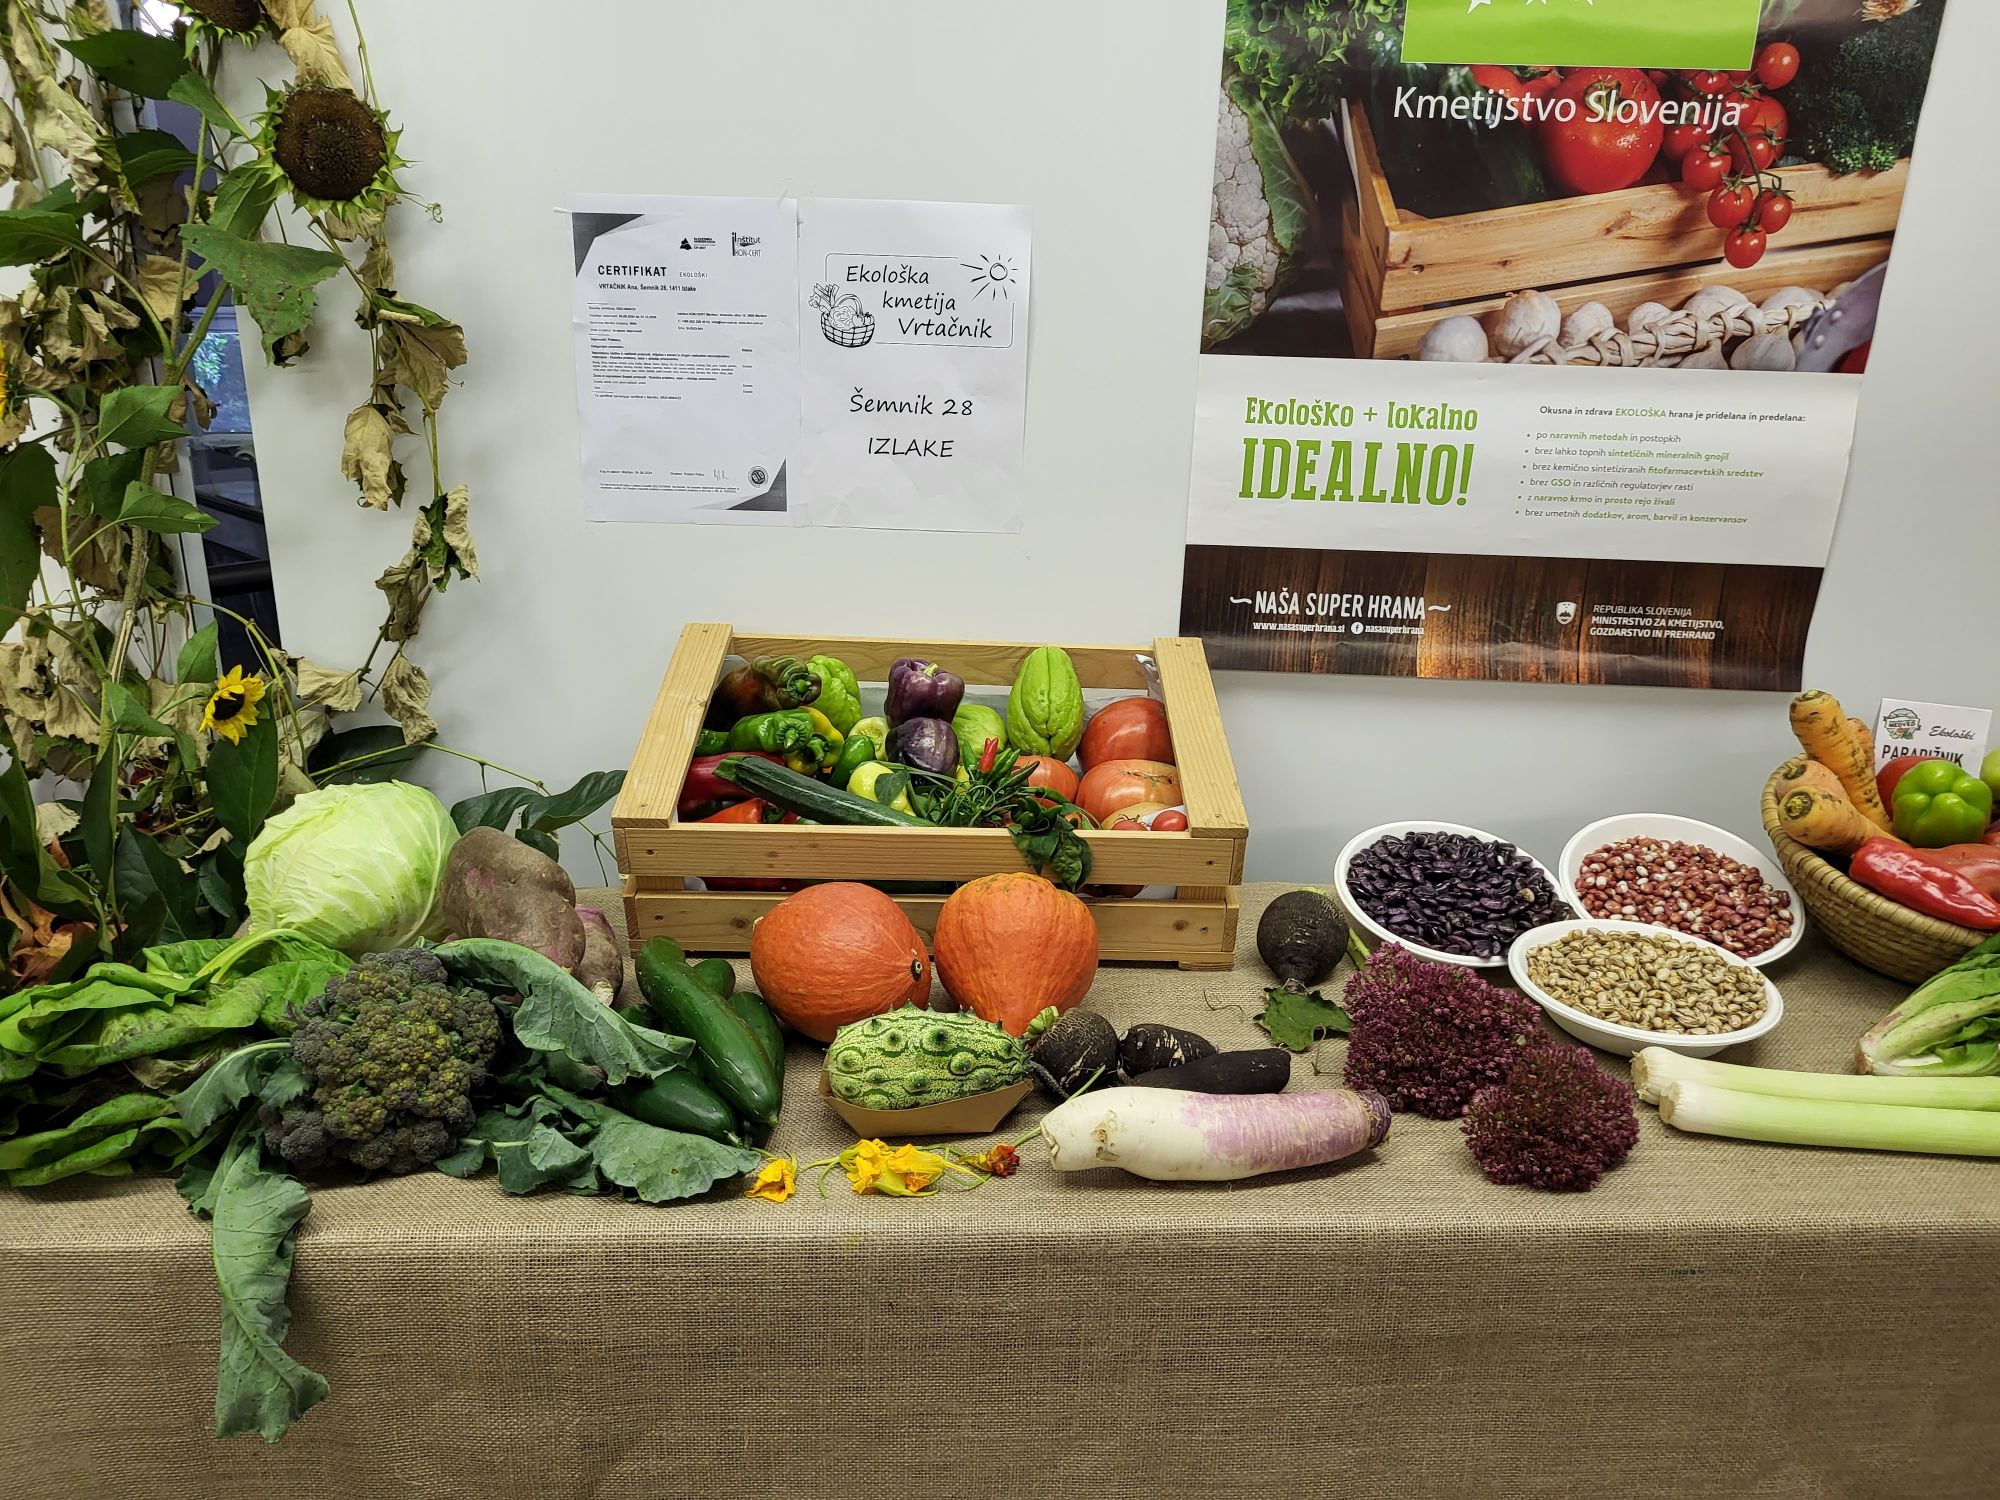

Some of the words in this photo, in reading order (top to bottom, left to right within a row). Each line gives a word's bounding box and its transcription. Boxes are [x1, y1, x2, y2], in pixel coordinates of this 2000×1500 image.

[1393, 86, 1577, 130] Kmetijstvo
[1585, 89, 1744, 135] Slovenija
[597, 265, 667, 277] CERTIFIKAT
[846, 264, 929, 284] Ekološka
[640, 283, 660, 291] Šemnik
[882, 290, 956, 316] kmetija
[898, 316, 992, 338] Vrtačnik
[850, 386, 933, 415] Šemnik
[942, 399, 973, 416] 28
[1245, 396, 1354, 428] Ekološko
[1363, 406, 1378, 422] +
[1387, 401, 1478, 431] lokalno
[1539, 406, 1572, 415] Okusna
[1574, 407, 1583, 415] in
[1585, 407, 1613, 416] zdrava
[1615, 407, 1666, 417] EKOLOŠKA
[1668, 410, 1693, 418] hrana
[1695, 411, 1703, 420] je
[1705, 411, 1747, 421] pridelana
[1749, 412, 1757, 420] in
[1759, 413, 1806, 423] predelana:
[1536, 432, 1548, 440] po
[1550, 432, 1587, 440] naravnih
[1589, 433, 1628, 441] metodah
[1639, 435, 1681, 444] postopkih
[868, 437, 954, 458] IZLAKE
[1534, 447, 1552, 455] brez
[1555, 447, 1577, 456] lahko
[1579, 448, 1606, 458] topnih
[1608, 449, 1654, 458] sintetičnih
[1656, 450, 1702, 460] mineralnih
[1705, 452, 1729, 462] gnojil
[1238, 437, 1475, 506] IDEALNO!
[1532, 462, 1551, 471] brez
[1553, 463, 1589, 472] kemično
[1591, 465, 1646, 474] sintetiziranih
[1648, 466, 1724, 476] fitofarmacevtskih
[1726, 469, 1764, 477] sredstev
[1530, 478, 1548, 486] brez
[1551, 478, 1571, 487] GSO
[1573, 479, 1581, 487] in
[1583, 479, 1618, 488] različnih
[1620, 481, 1673, 492] regulatorjev
[1674, 482, 1694, 491] rasti
[1570, 495, 1593, 503] krmo
[1604, 496, 1633, 505] prosto
[1635, 497, 1652, 507] rejo
[1653, 497, 1676, 505] živali
[1525, 508, 1543, 517] brez
[1545, 509, 1580, 518] umetnih
[1582, 510, 1625, 520] dodatkov,
[1627, 513, 1651, 521] arom,
[1653, 513, 1678, 521] barvil
[1689, 514, 1748, 523] konzervansov
[1255, 586, 1299, 615] NAŠA
[1305, 592, 1363, 618] SUPER
[1367, 594, 1426, 620] HRANA
[1593, 604, 1644, 615] REPUBLIKA
[1645, 606, 1692, 617] SLOVENIJA
[1252, 621, 1345, 634] www.nasasuperhrana.si
[1365, 624, 1425, 636] nasasuperhrana
[1591, 616, 1652, 627] MINISTRSTVO
[1653, 618, 1666, 627] ZA
[1667, 618, 1724, 630] KMETIJSTVO,
[1589, 627, 1651, 638] GOZDARSTVO
[1651, 629, 1662, 638] IN
[1664, 630, 1716, 640] PREHRANO
[1928, 725, 1976, 740] Ekološki
